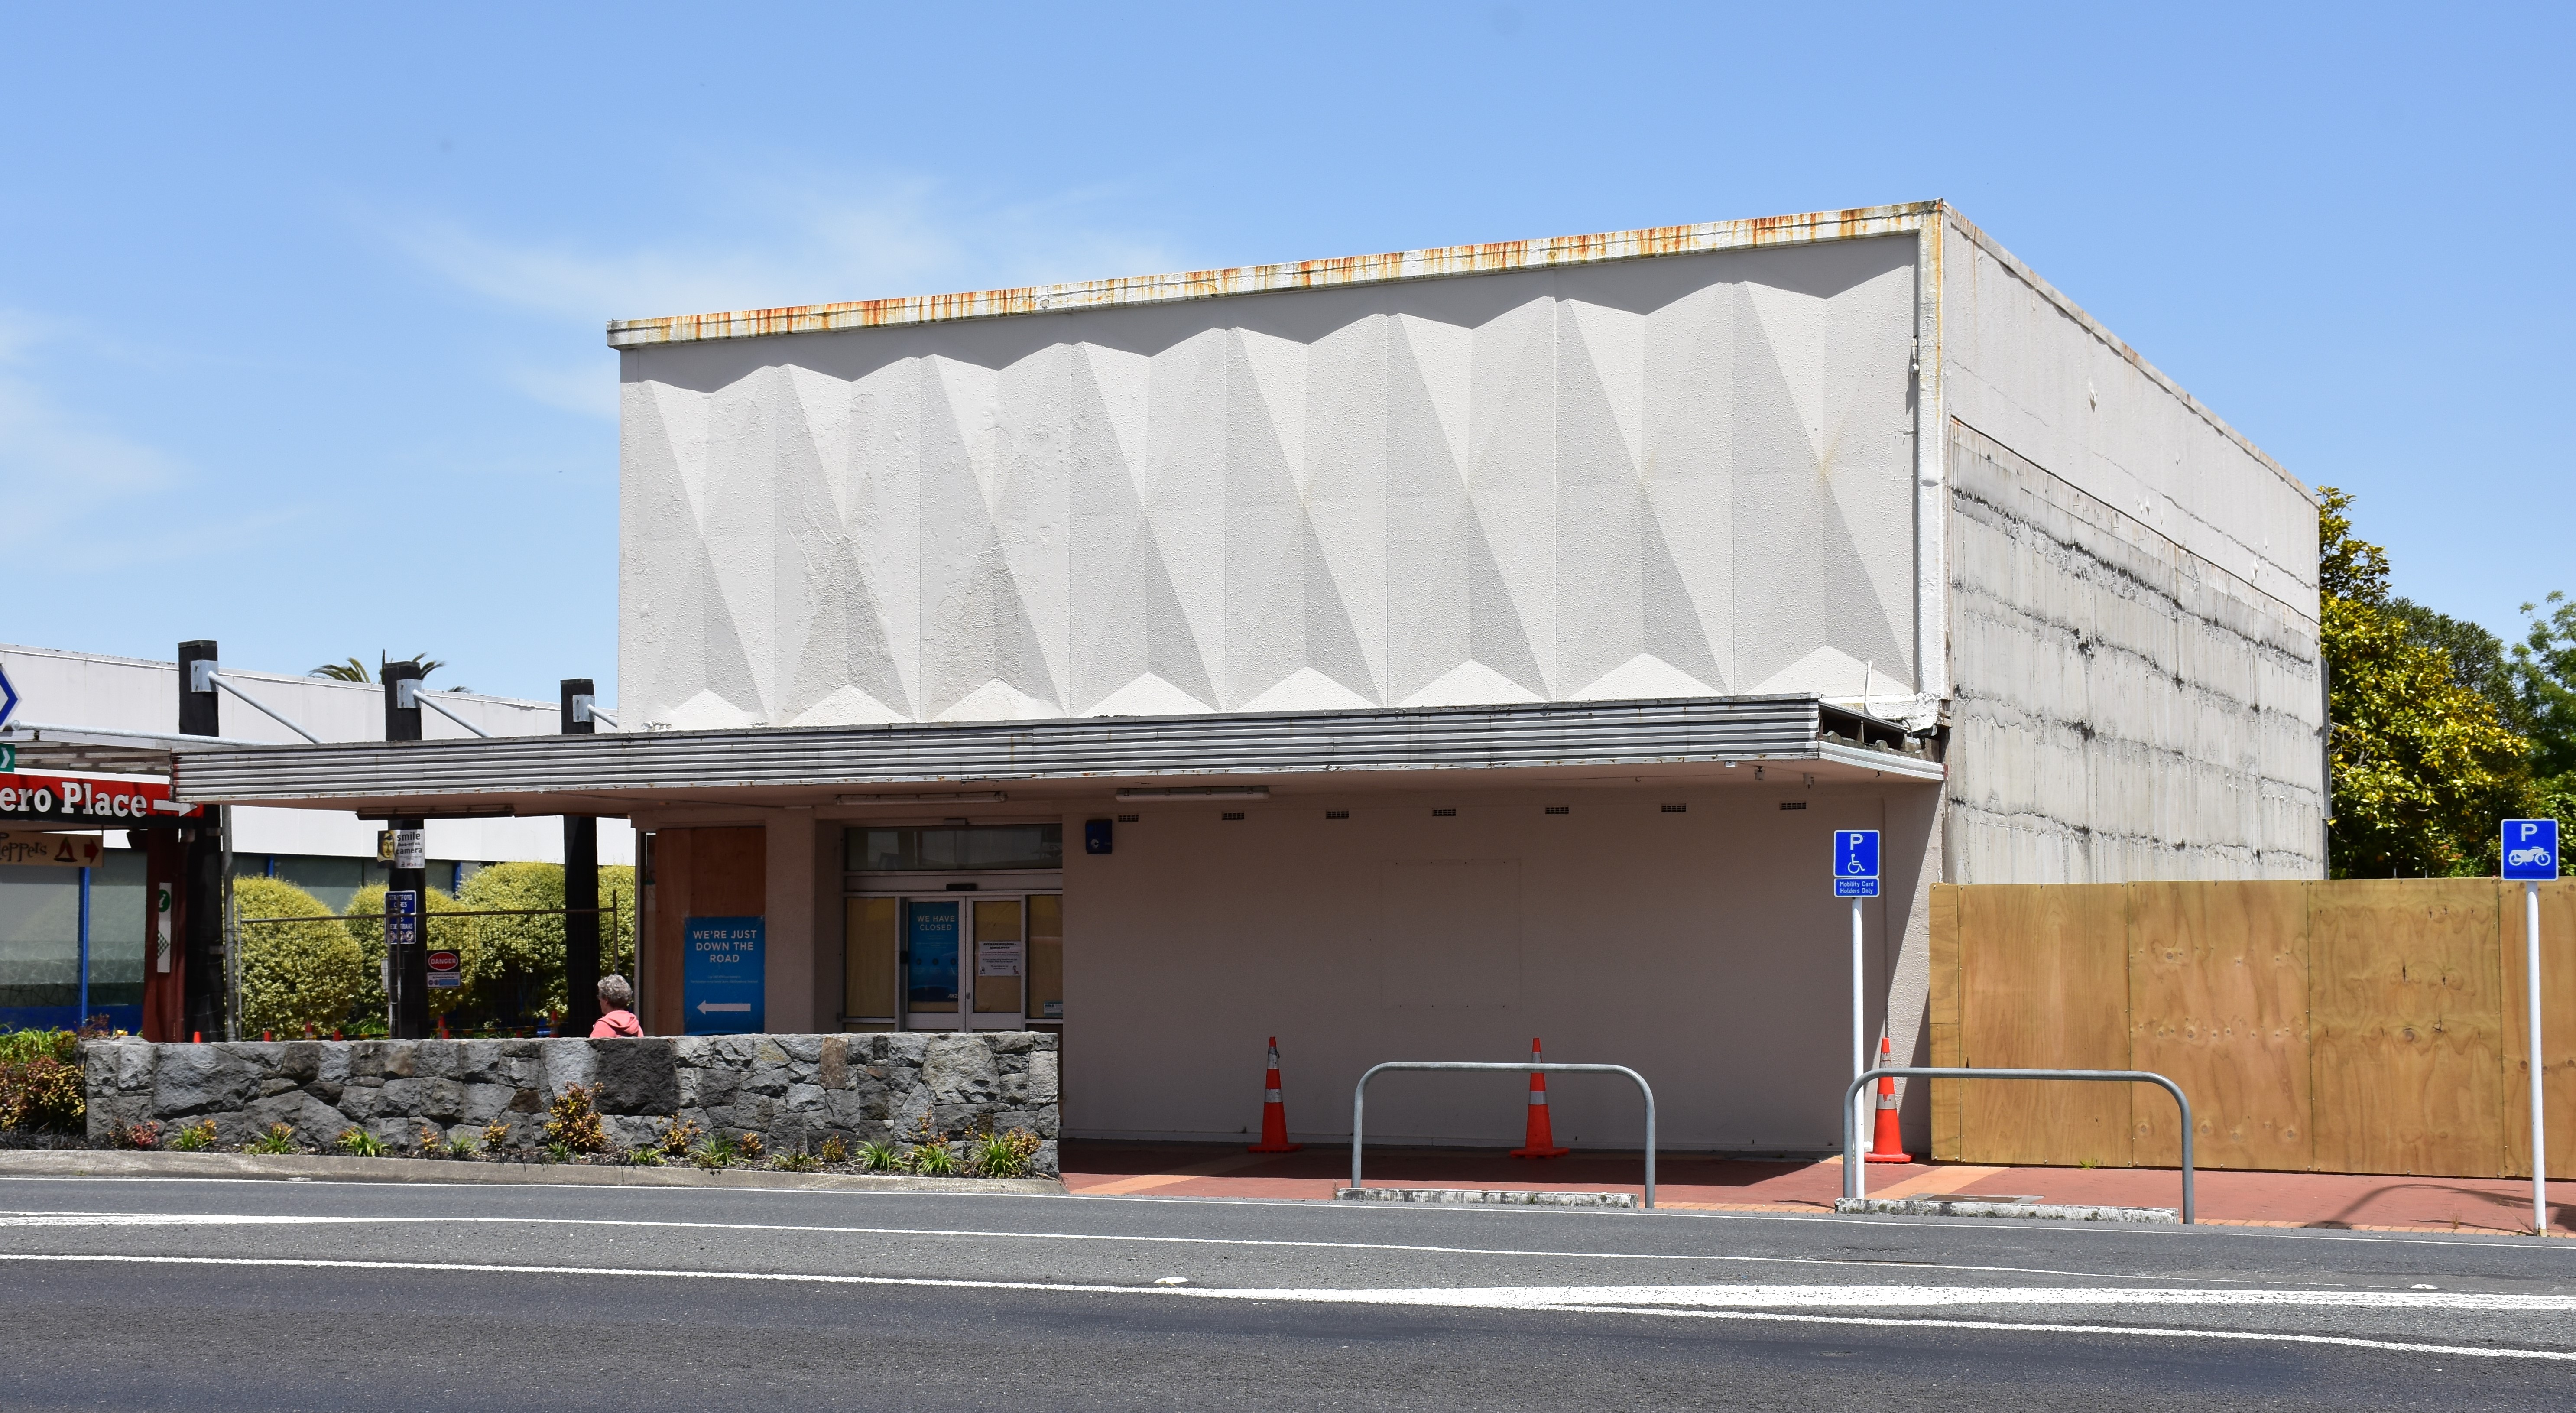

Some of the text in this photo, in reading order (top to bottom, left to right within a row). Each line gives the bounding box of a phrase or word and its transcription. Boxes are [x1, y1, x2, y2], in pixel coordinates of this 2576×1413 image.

[0, 782, 147, 817] ero Place
[397, 832, 421, 841] smile
[2521, 824, 2537, 841] P
[1850, 834, 1863, 850] P
[693, 930, 757, 939] WE'RE JUST
[696, 942, 753, 951] DOWN THE
[710, 954, 740, 962] ROAD
